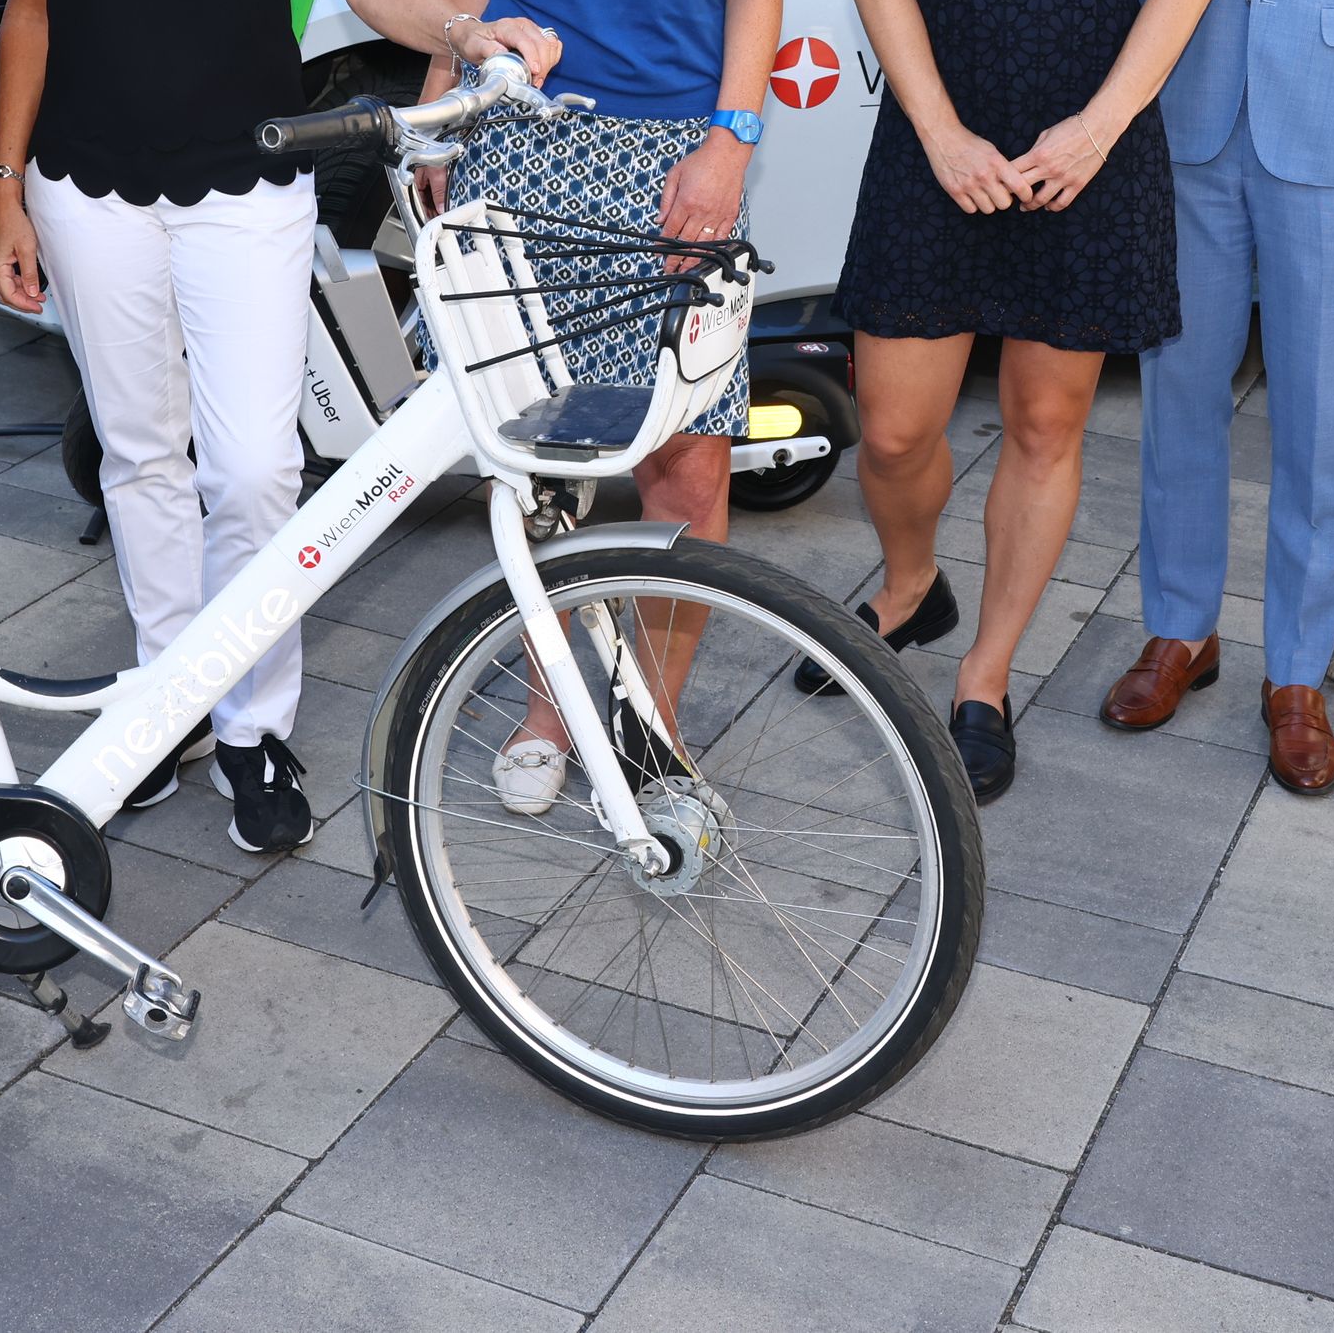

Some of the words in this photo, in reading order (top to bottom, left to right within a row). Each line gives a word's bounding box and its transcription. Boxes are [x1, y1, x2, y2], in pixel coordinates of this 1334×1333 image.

[311, 380, 341, 422] Uber
[316, 463, 403, 548] WienMobil
[387, 475, 415, 503] Rad
[480, 608, 503, 629] DELTA
[92, 587, 299, 785] nextbike
[418, 663, 449, 715] SCHWALBE
